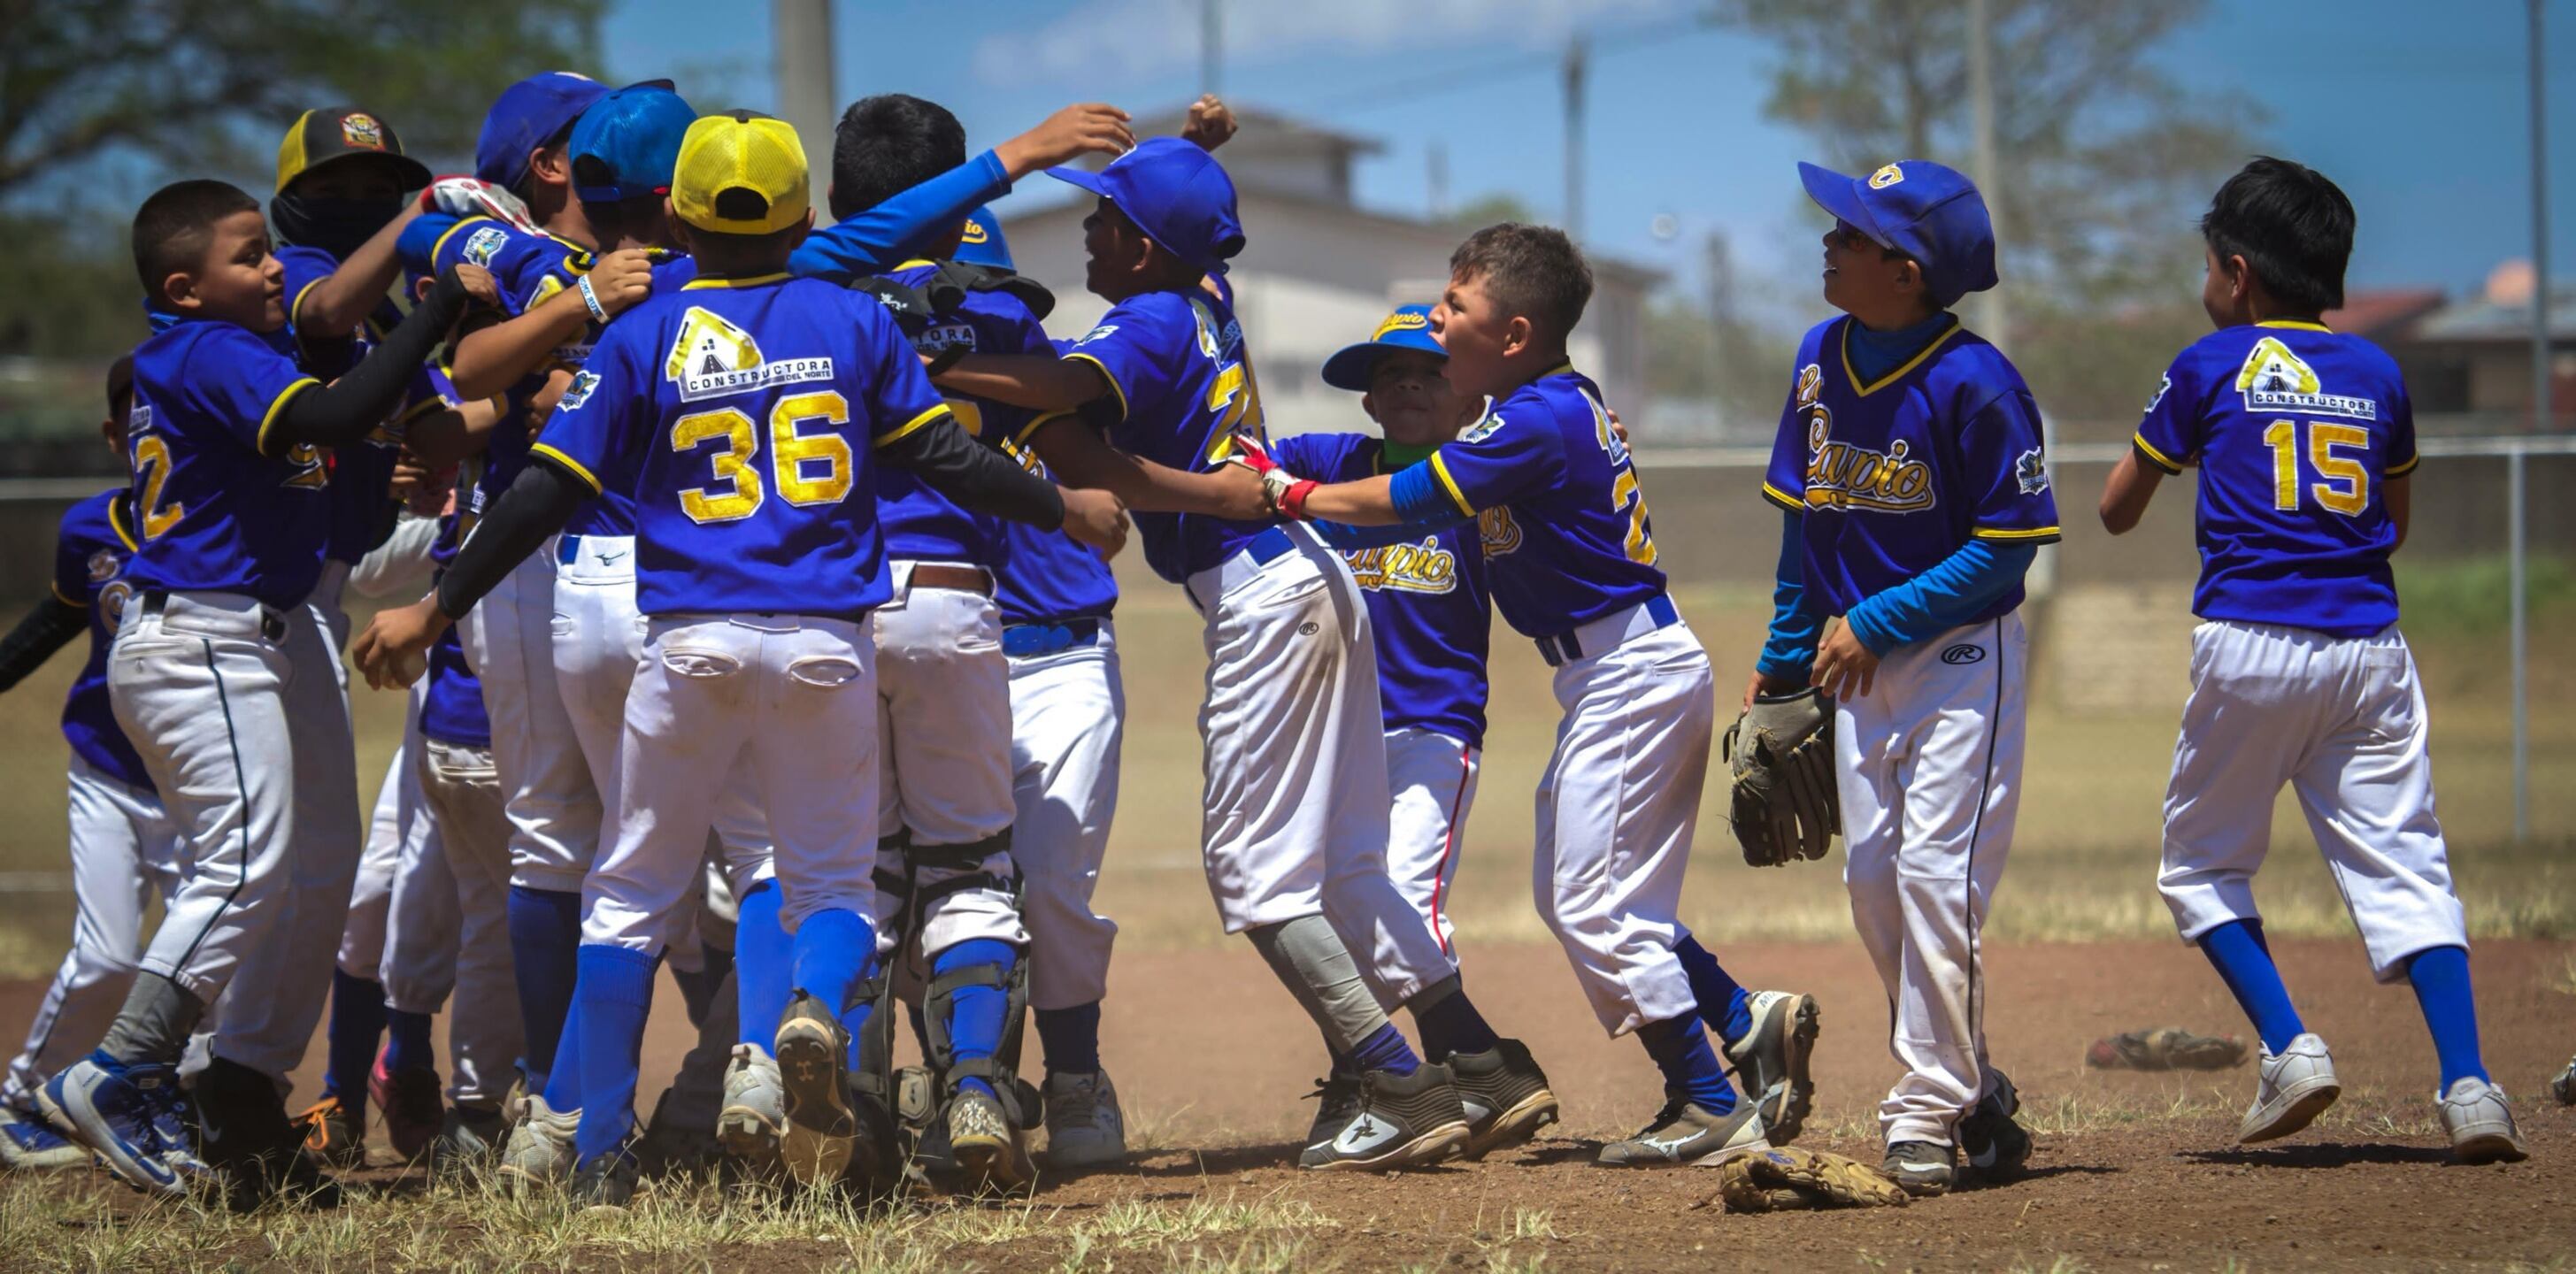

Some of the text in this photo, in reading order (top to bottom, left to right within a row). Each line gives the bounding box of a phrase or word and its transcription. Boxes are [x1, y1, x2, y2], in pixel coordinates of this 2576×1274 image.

[689, 360, 830, 391] CONSTRUCTORA
[804, 371, 831, 380] NORTE
[2256, 394, 2374, 411] CONSTRUCTORA
[671, 389, 853, 525] 36
[2263, 418, 2370, 518] 15
[1339, 535, 1457, 595] arpio
